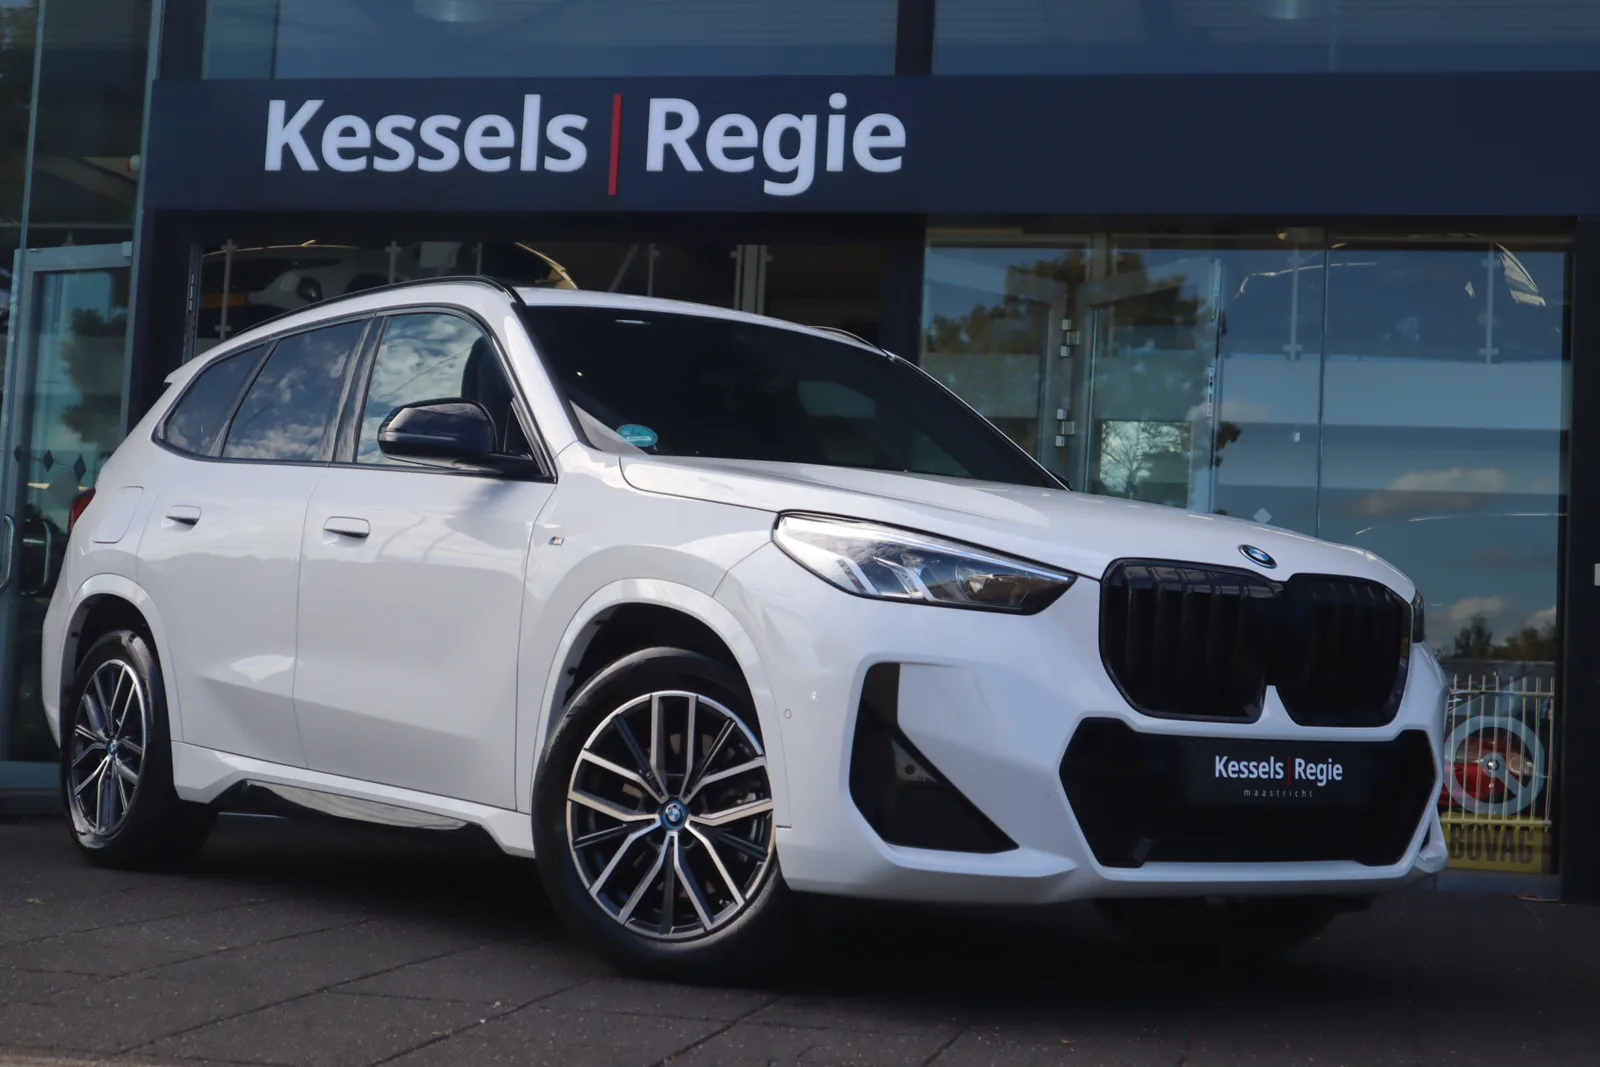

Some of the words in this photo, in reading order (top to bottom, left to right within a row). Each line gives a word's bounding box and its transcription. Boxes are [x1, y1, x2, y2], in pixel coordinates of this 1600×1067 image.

[264, 93, 589, 173] Kessels
[645, 92, 907, 197] Regie
[1215, 755, 1284, 779] Kessels
[1295, 758, 1343, 787] Regie
[1243, 789, 1313, 798] maastricht
[1450, 823, 1534, 864] BOVAG
